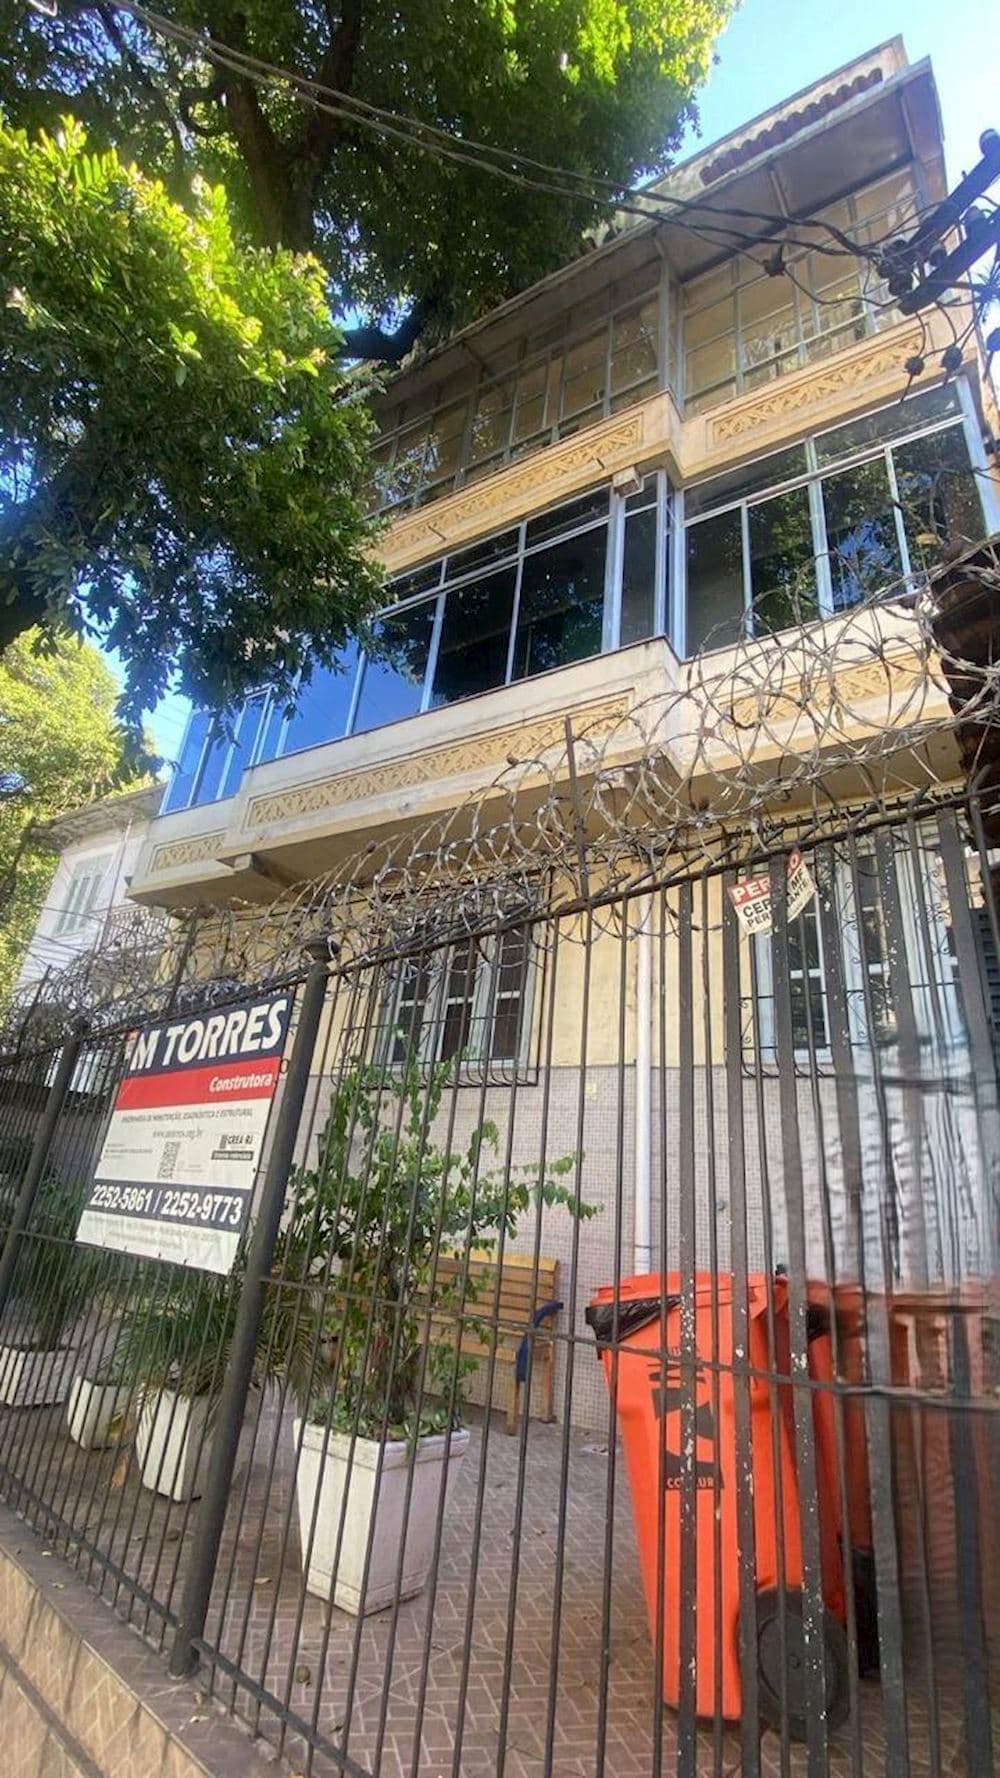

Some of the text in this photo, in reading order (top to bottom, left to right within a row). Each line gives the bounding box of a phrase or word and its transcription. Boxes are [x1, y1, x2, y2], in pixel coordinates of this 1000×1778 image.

[162, 999, 287, 1067] TORRES
[209, 1073, 273, 1093] Construtora
[90, 1185, 153, 1213] 2252-5861
[161, 1191, 244, 1225] 2252-9773
